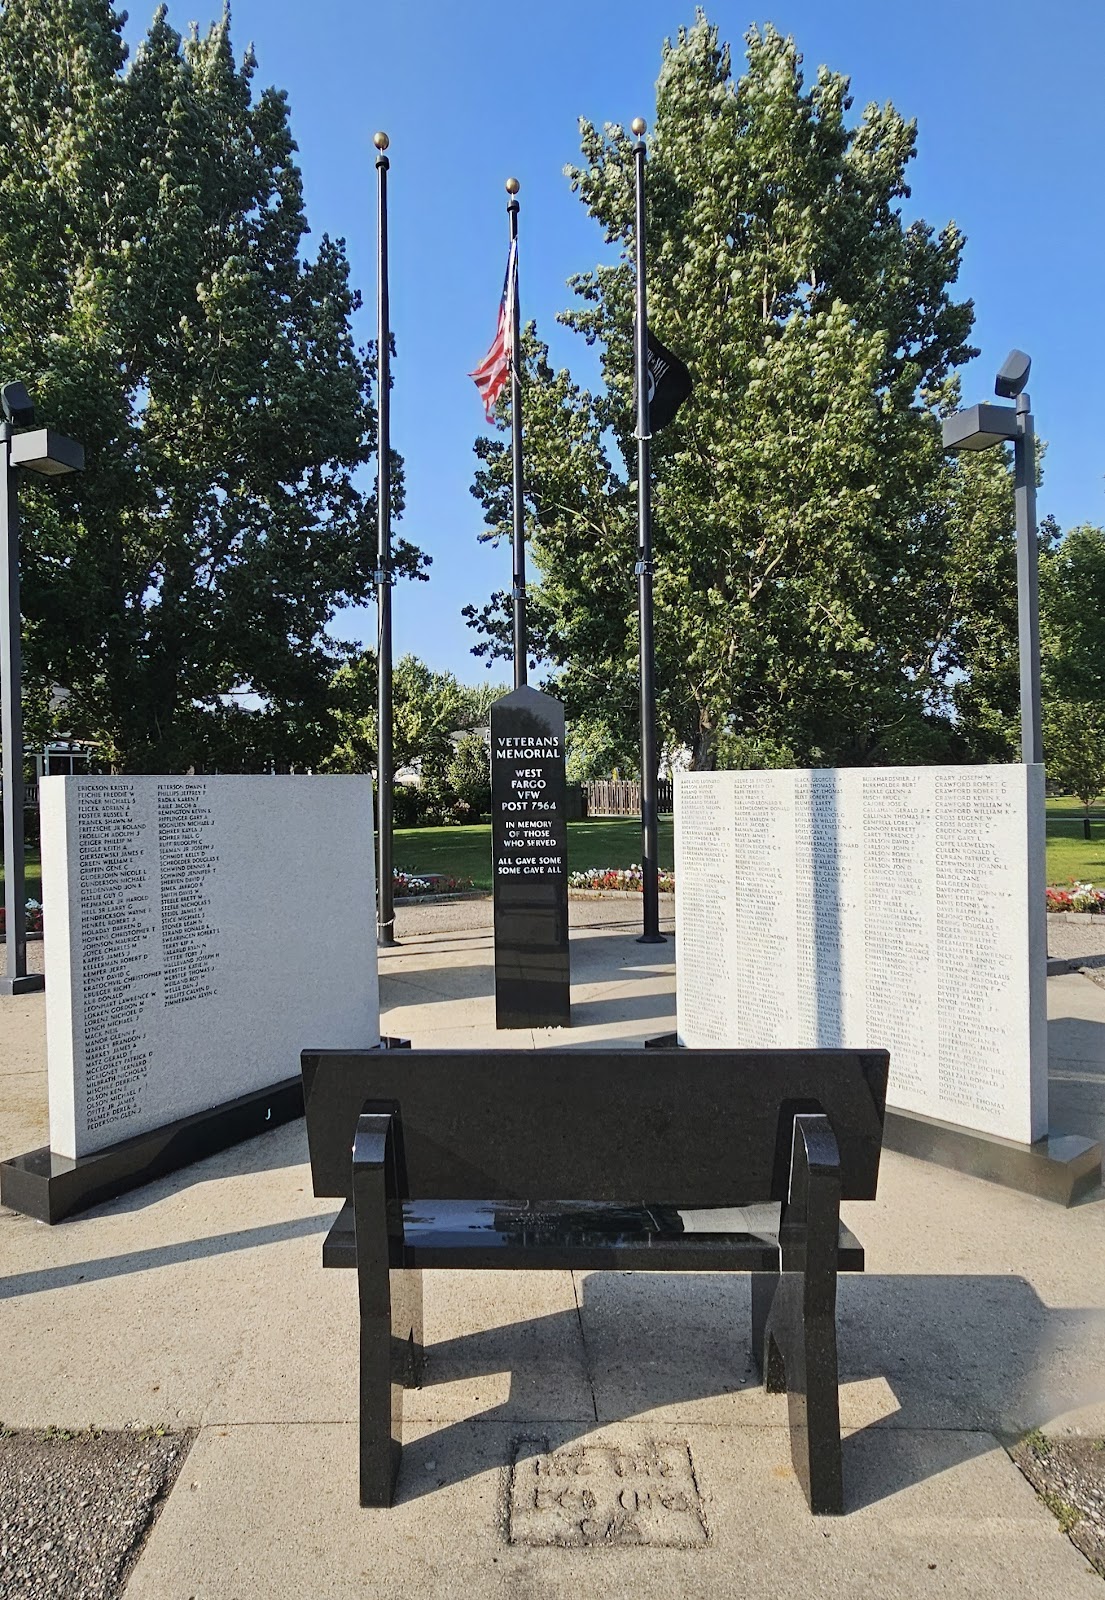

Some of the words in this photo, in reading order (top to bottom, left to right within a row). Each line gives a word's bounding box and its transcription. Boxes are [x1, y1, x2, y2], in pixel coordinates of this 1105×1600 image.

[498, 737, 558, 747] VETERANS
[497, 749, 560, 759] MEMORIAL
[515, 769, 542, 778] WEST
[511, 780, 546, 789] FARGO
[517, 791, 540, 799] VFW
[502, 802, 528, 811] POST
[531, 801, 556, 810] 7564
[506, 821, 515, 829] IN
[518, 820, 552, 828] MEMORY
[509, 830, 520, 838] OF
[527, 839, 556, 847] SERVED
[547, 866, 561, 874] ALL
[265, 1108, 270, 1120] J
